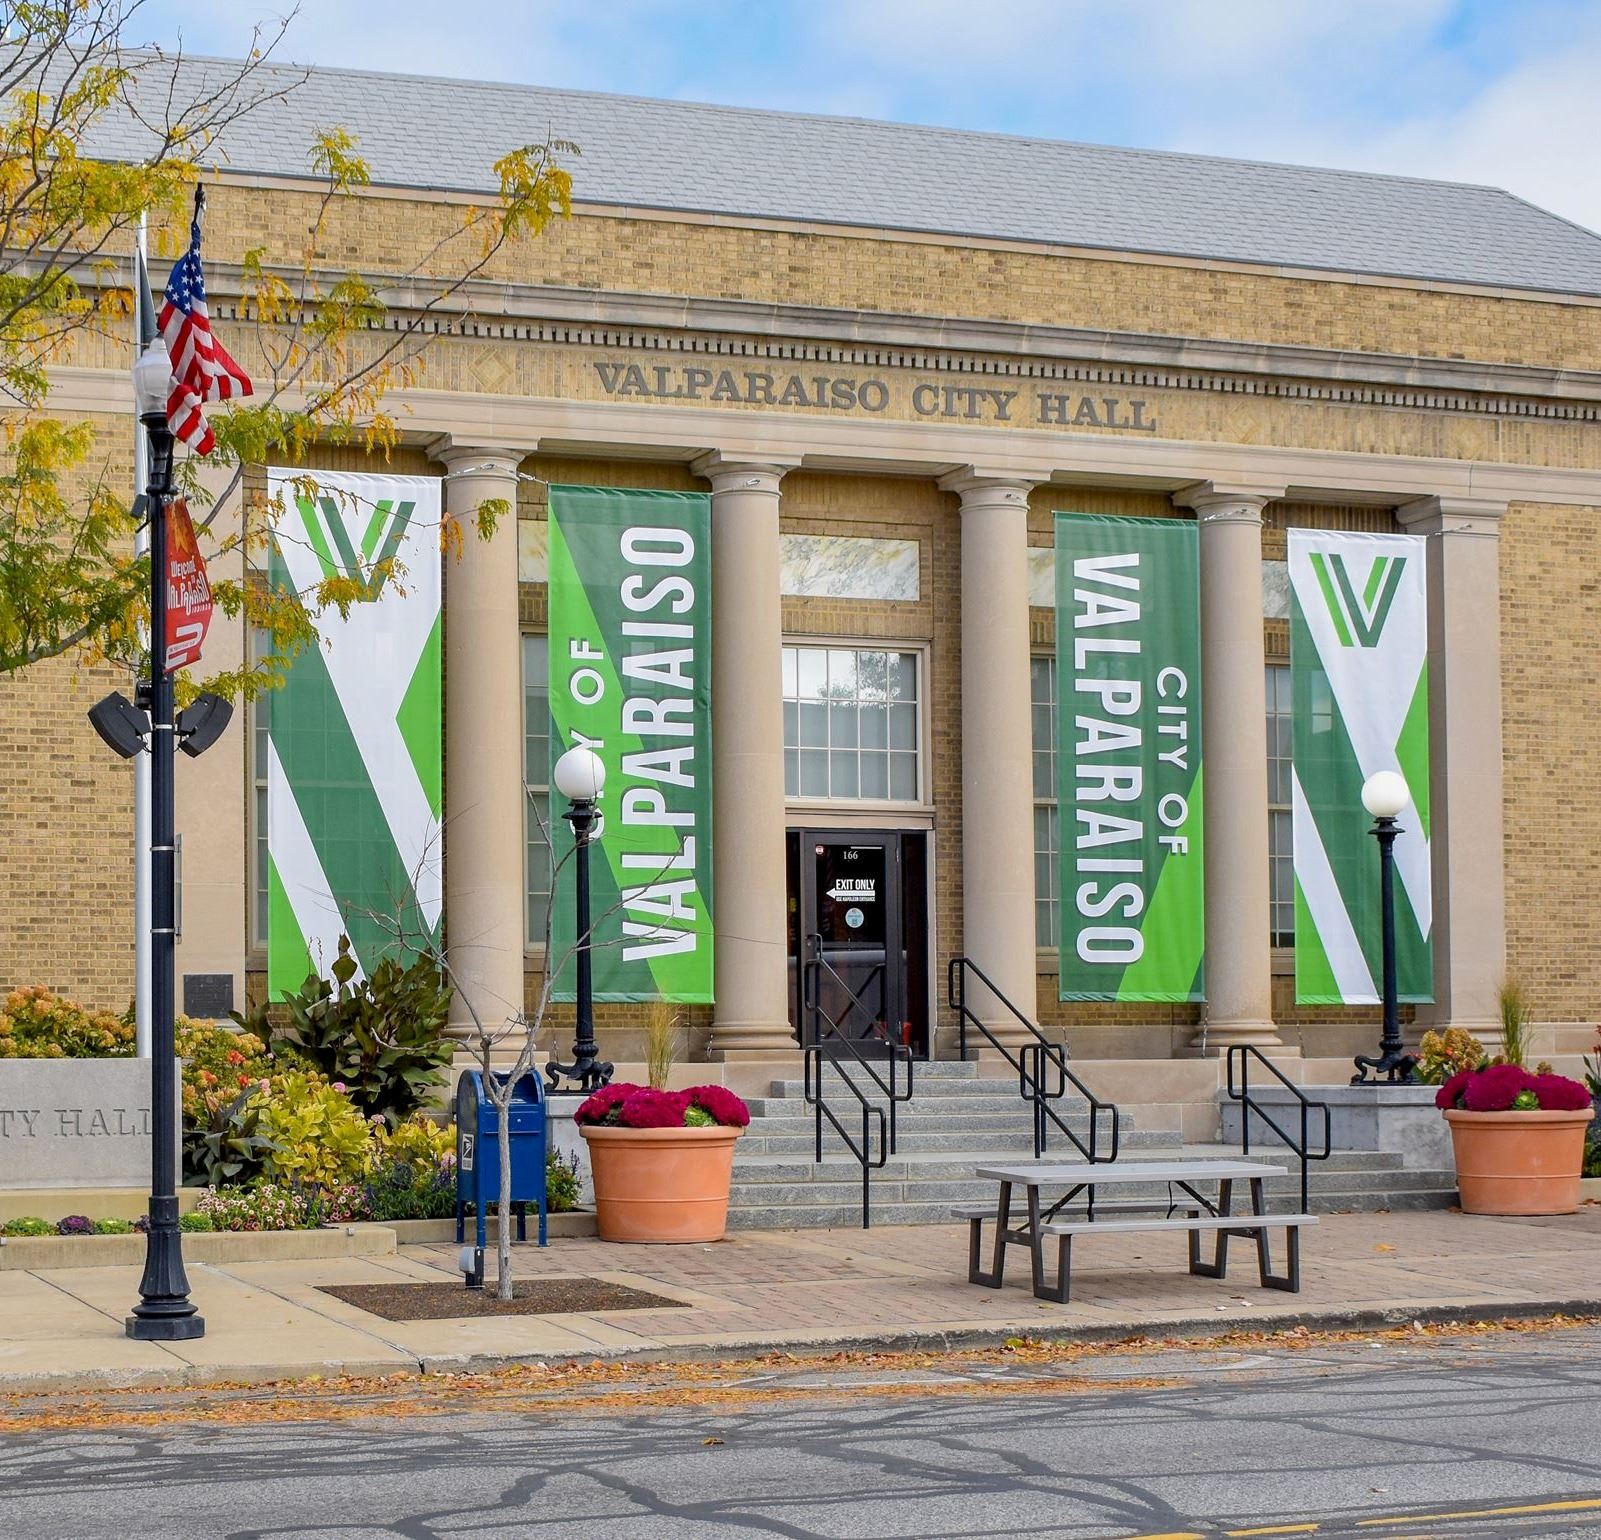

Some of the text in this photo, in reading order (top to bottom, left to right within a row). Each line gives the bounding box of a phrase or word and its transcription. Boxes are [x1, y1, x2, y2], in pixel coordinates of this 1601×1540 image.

[593, 361, 1157, 431] VALPARAISO CITY HALL
[569, 640, 605, 705] OF
[620, 526, 697, 962] VALPARAISO
[1073, 552, 1145, 965] VALPARAISO
[1156, 666, 1189, 856] CITY OF
[836, 879, 875, 890] EXIT ONLY
[843, 851, 858, 860] 166
